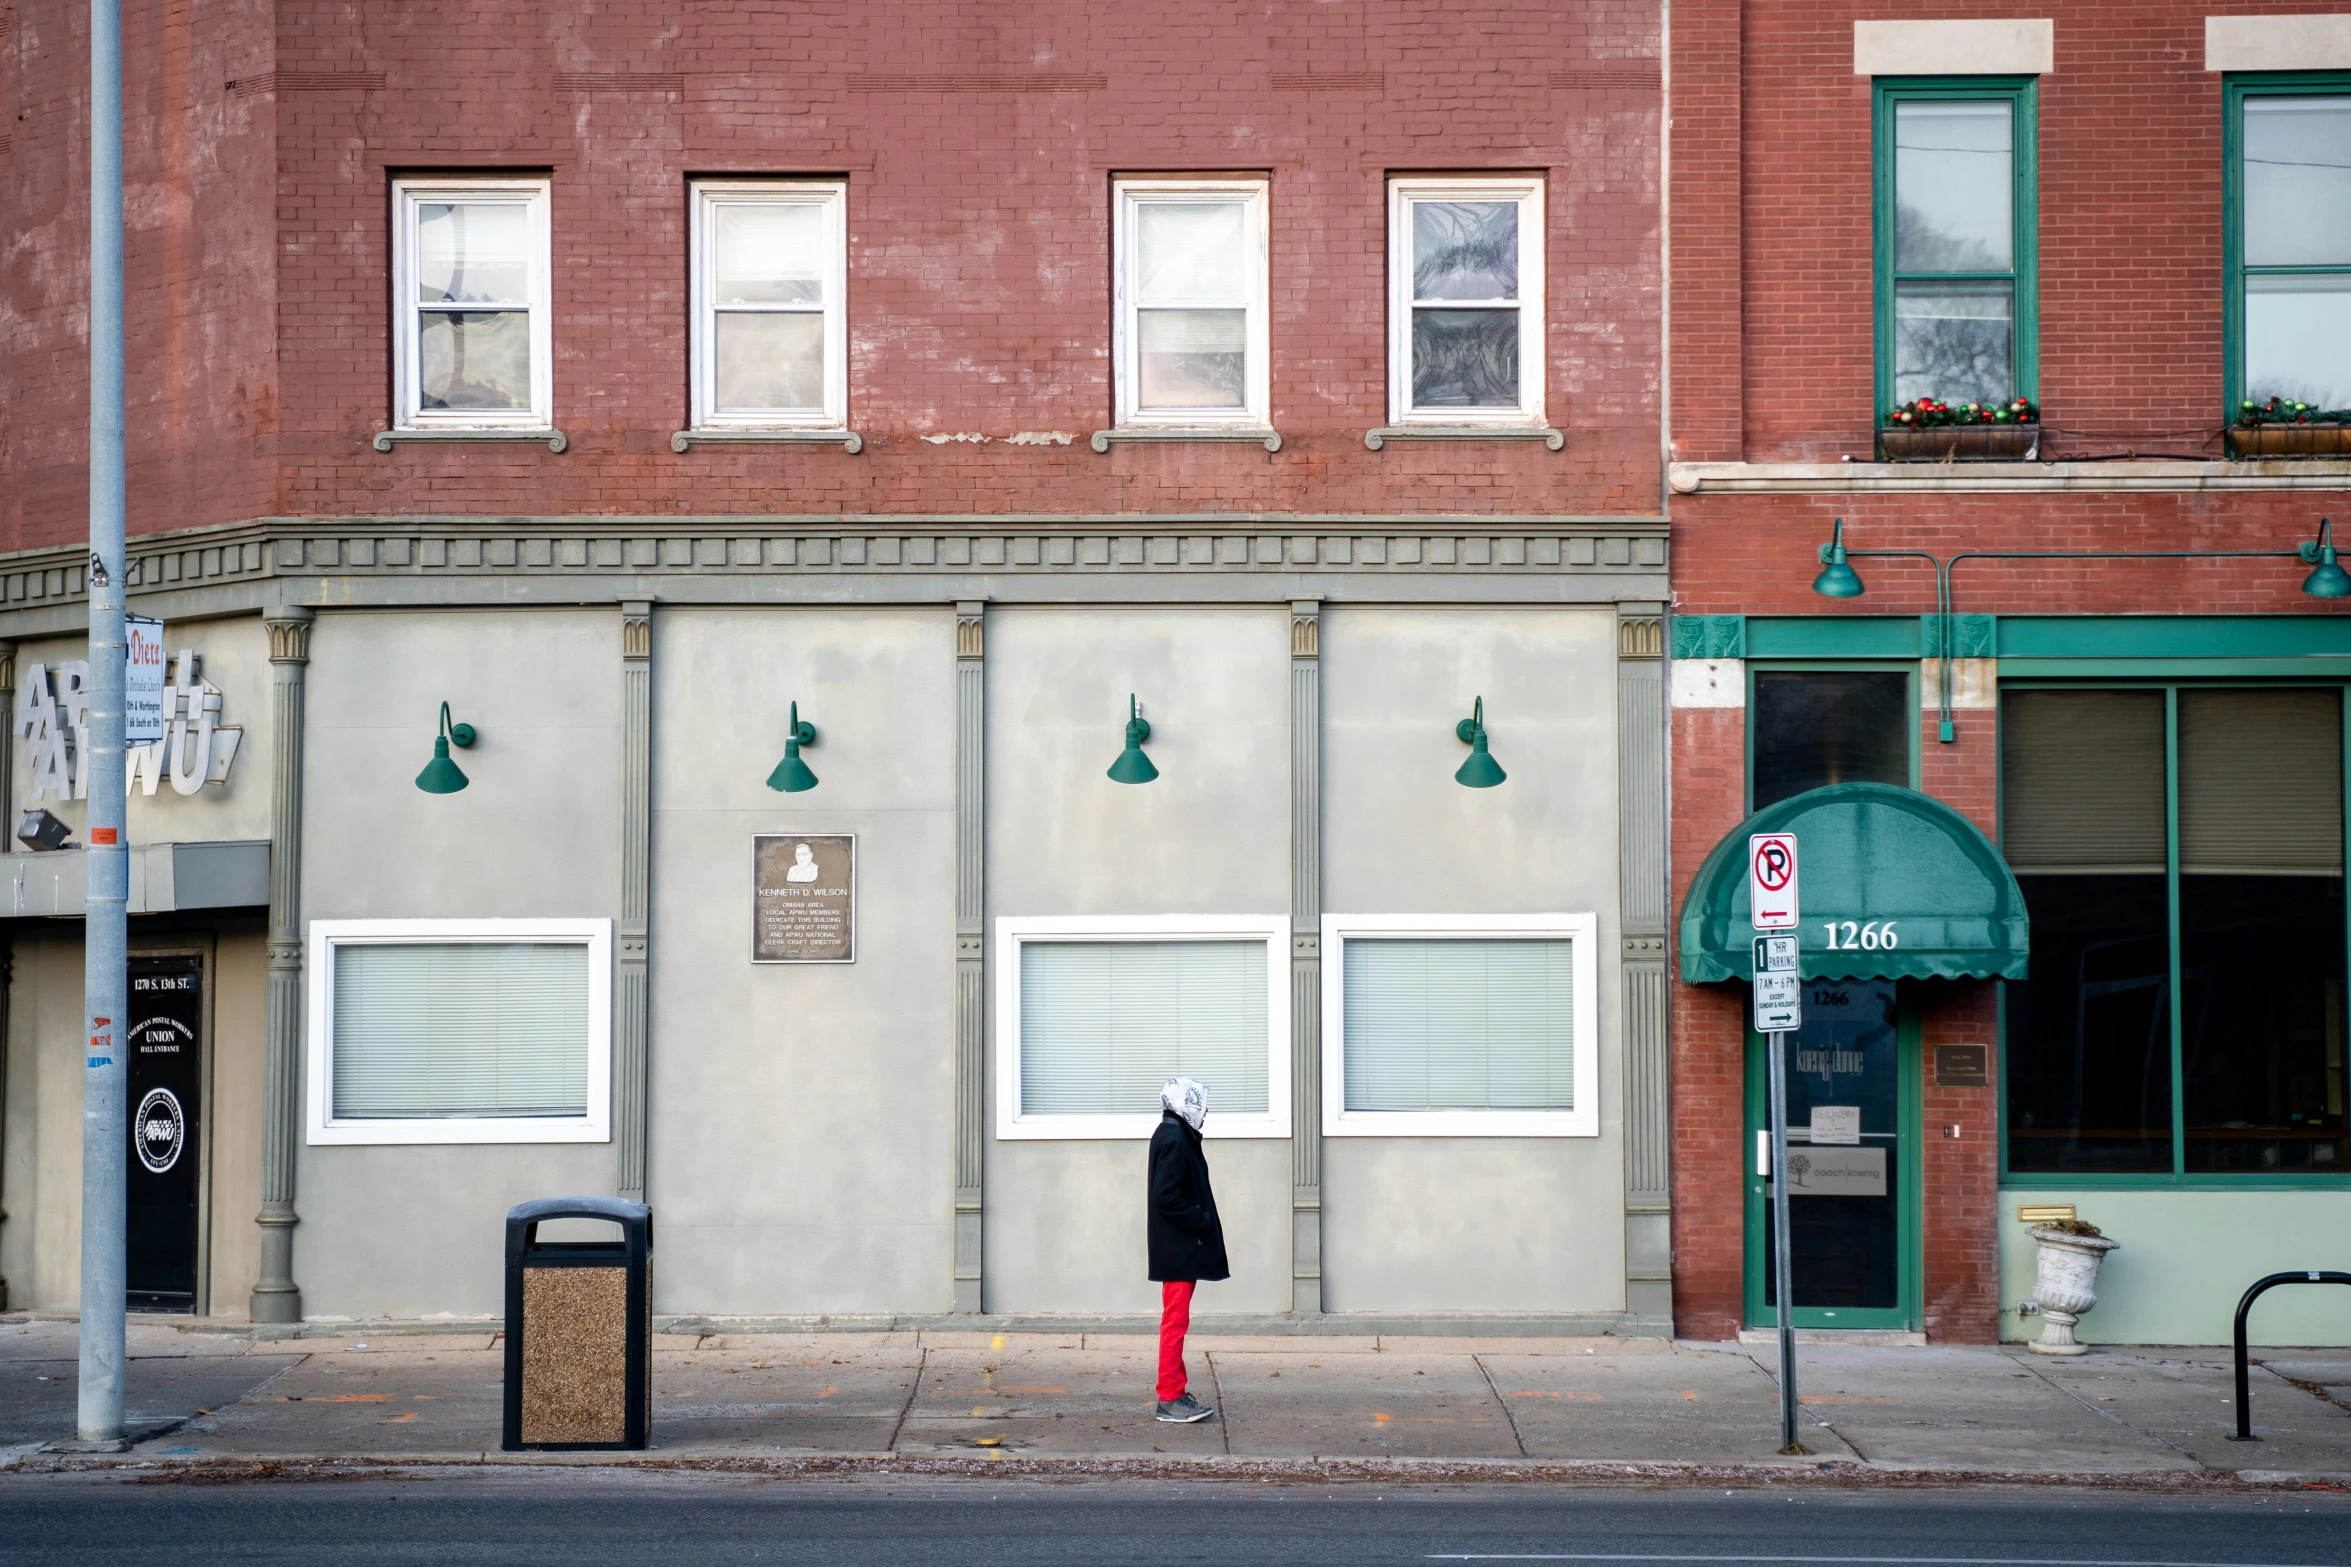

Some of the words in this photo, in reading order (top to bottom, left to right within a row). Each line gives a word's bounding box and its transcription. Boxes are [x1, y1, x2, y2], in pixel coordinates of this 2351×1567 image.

[131, 629, 160, 665] Dietz
[136, 717, 146, 727] South
[758, 888, 800, 896] KENNETH
[802, 888, 810, 896] D.
[814, 888, 848, 896] WILSON
[1824, 921, 1898, 950] 1266
[1776, 942, 1787, 953] HR
[1758, 944, 1764, 968] 1
[1769, 956, 1794, 968] PARKING
[135, 979, 149, 990] 1270
[151, 979, 158, 990] S.
[161, 979, 175, 989] 13th
[178, 978, 190, 989] ST.
[1813, 991, 1849, 1006] 1266
[128, 1019, 151, 1040] AMERICAN
[171, 1019, 193, 1040] WORKERS
[146, 1031, 175, 1042] UNION
[1814, 1110, 1856, 1119] DELIVERY
[1814, 1168, 1845, 1176] coach
[1848, 1168, 1880, 1179] koenig
